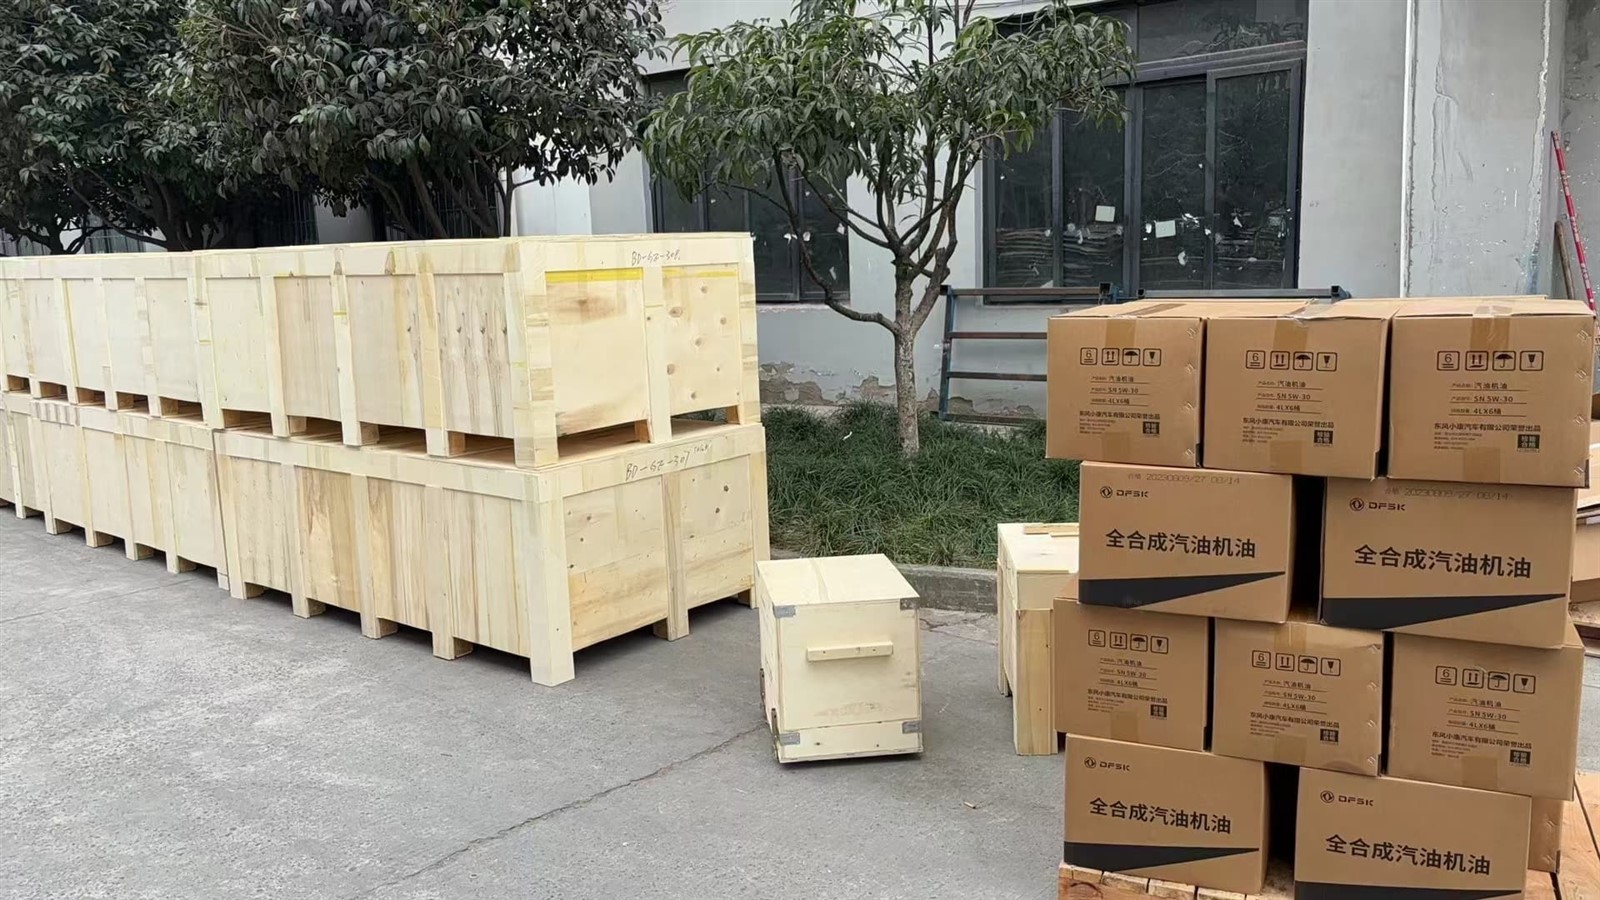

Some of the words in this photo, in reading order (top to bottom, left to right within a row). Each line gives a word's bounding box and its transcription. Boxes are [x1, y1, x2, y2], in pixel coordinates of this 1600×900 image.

[1474, 382, 1508, 390] 汽油机油
[1116, 490, 1149, 498] DFSK
[1368, 502, 1406, 511] DFSK
[1105, 528, 1256, 559] 全合成汽油机油
[1354, 544, 1531, 579] 全合成汽油机油
[1294, 693, 1316, 701] 5W-30
[1482, 712, 1507, 720] 5W-30
[1099, 761, 1131, 772] DFSK
[1338, 795, 1374, 807] DFSK
[1089, 797, 1231, 835] 全合成汽油机油
[1325, 834, 1490, 876] 全合成汽油机油
